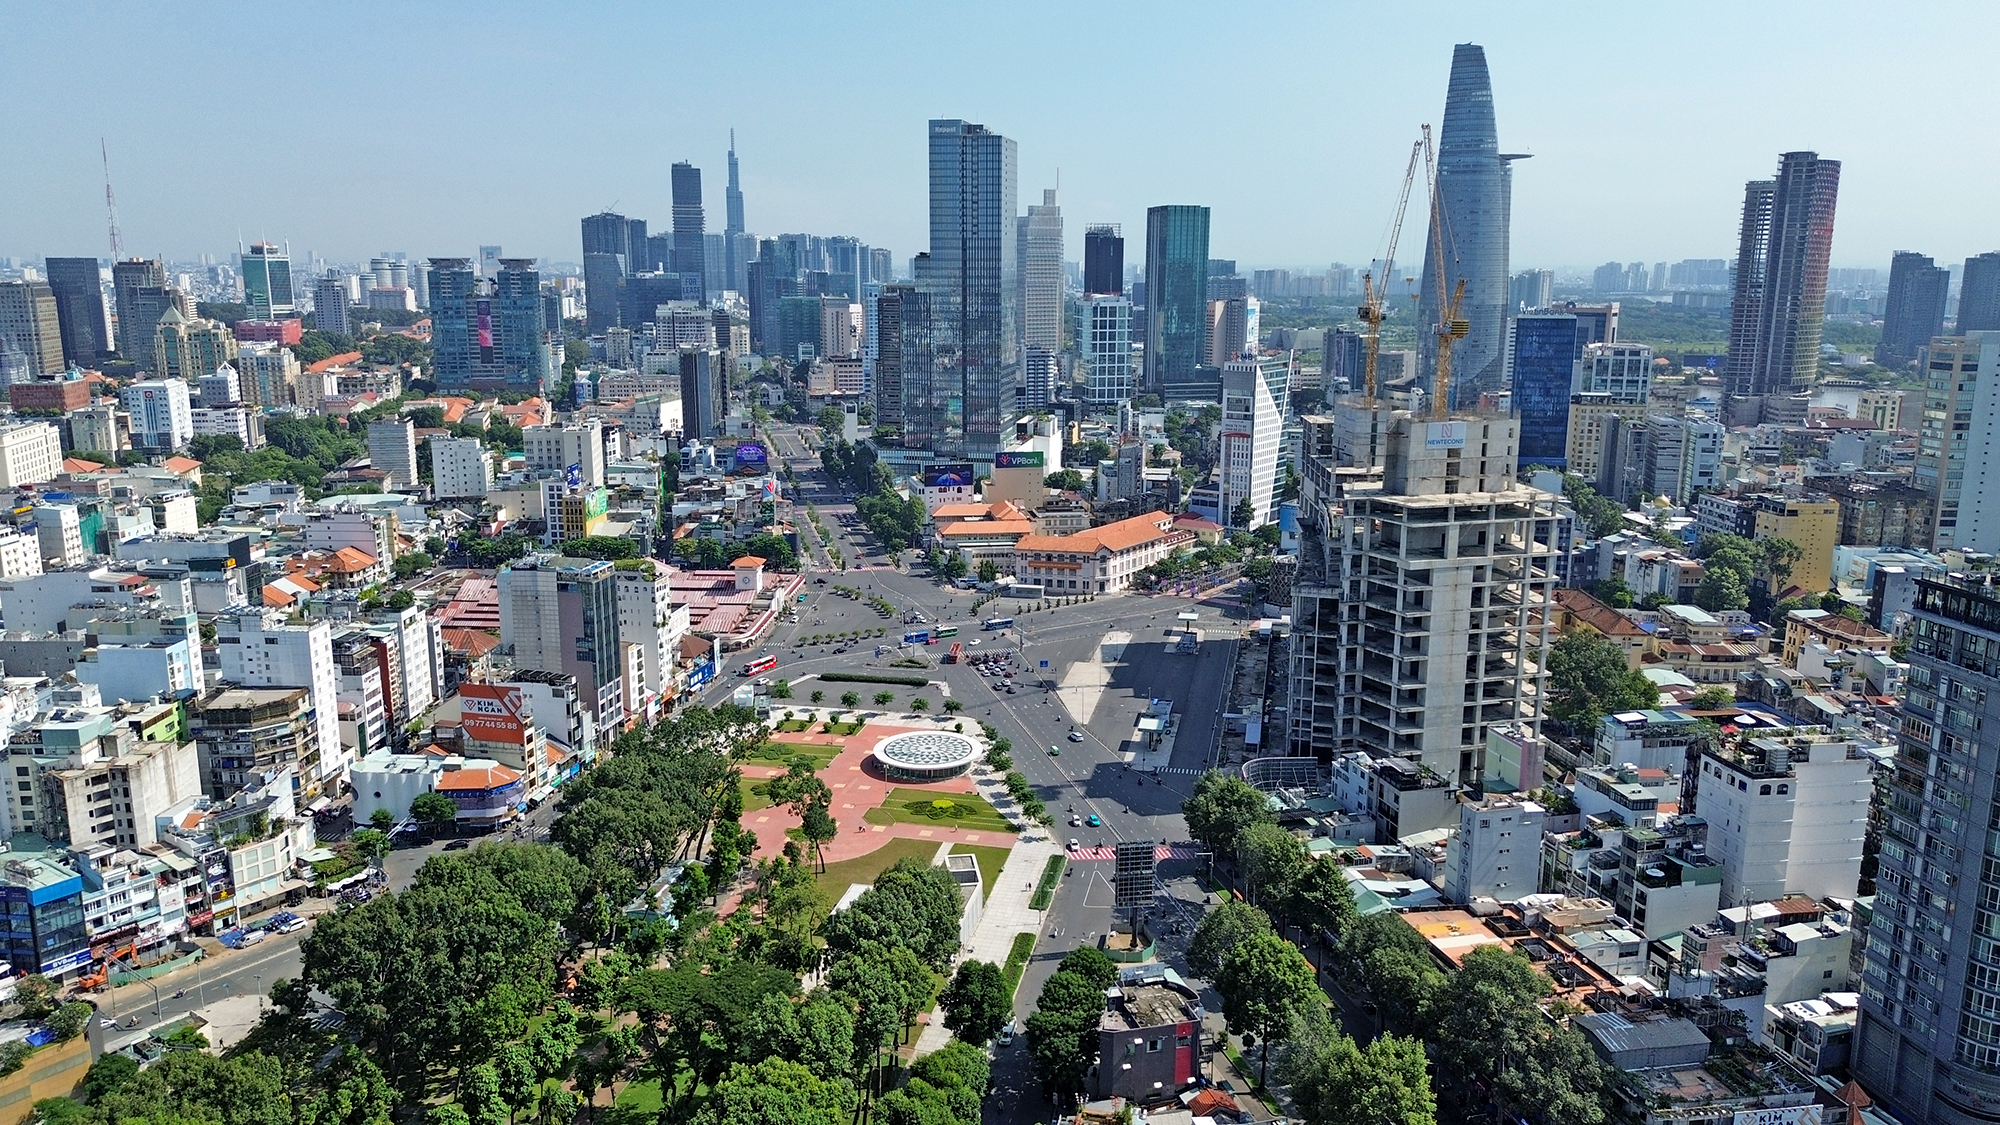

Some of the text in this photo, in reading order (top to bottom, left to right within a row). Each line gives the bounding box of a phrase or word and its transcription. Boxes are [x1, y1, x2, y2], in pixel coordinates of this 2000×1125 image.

[685, 278, 697, 286] FOR
[682, 286, 701, 294] LEASE
[1240, 353, 1253, 361] MB
[1427, 438, 1464, 446] NEWTECONS
[1011, 457, 1040, 465] VPBank
[464, 719, 475, 727] 09
[485, 720, 496, 728] 44
[496, 722, 507, 730] 55
[507, 722, 518, 730] 88
[52, 956, 77, 968] BVBank
[1759, 1114, 1783, 1124] KIM
